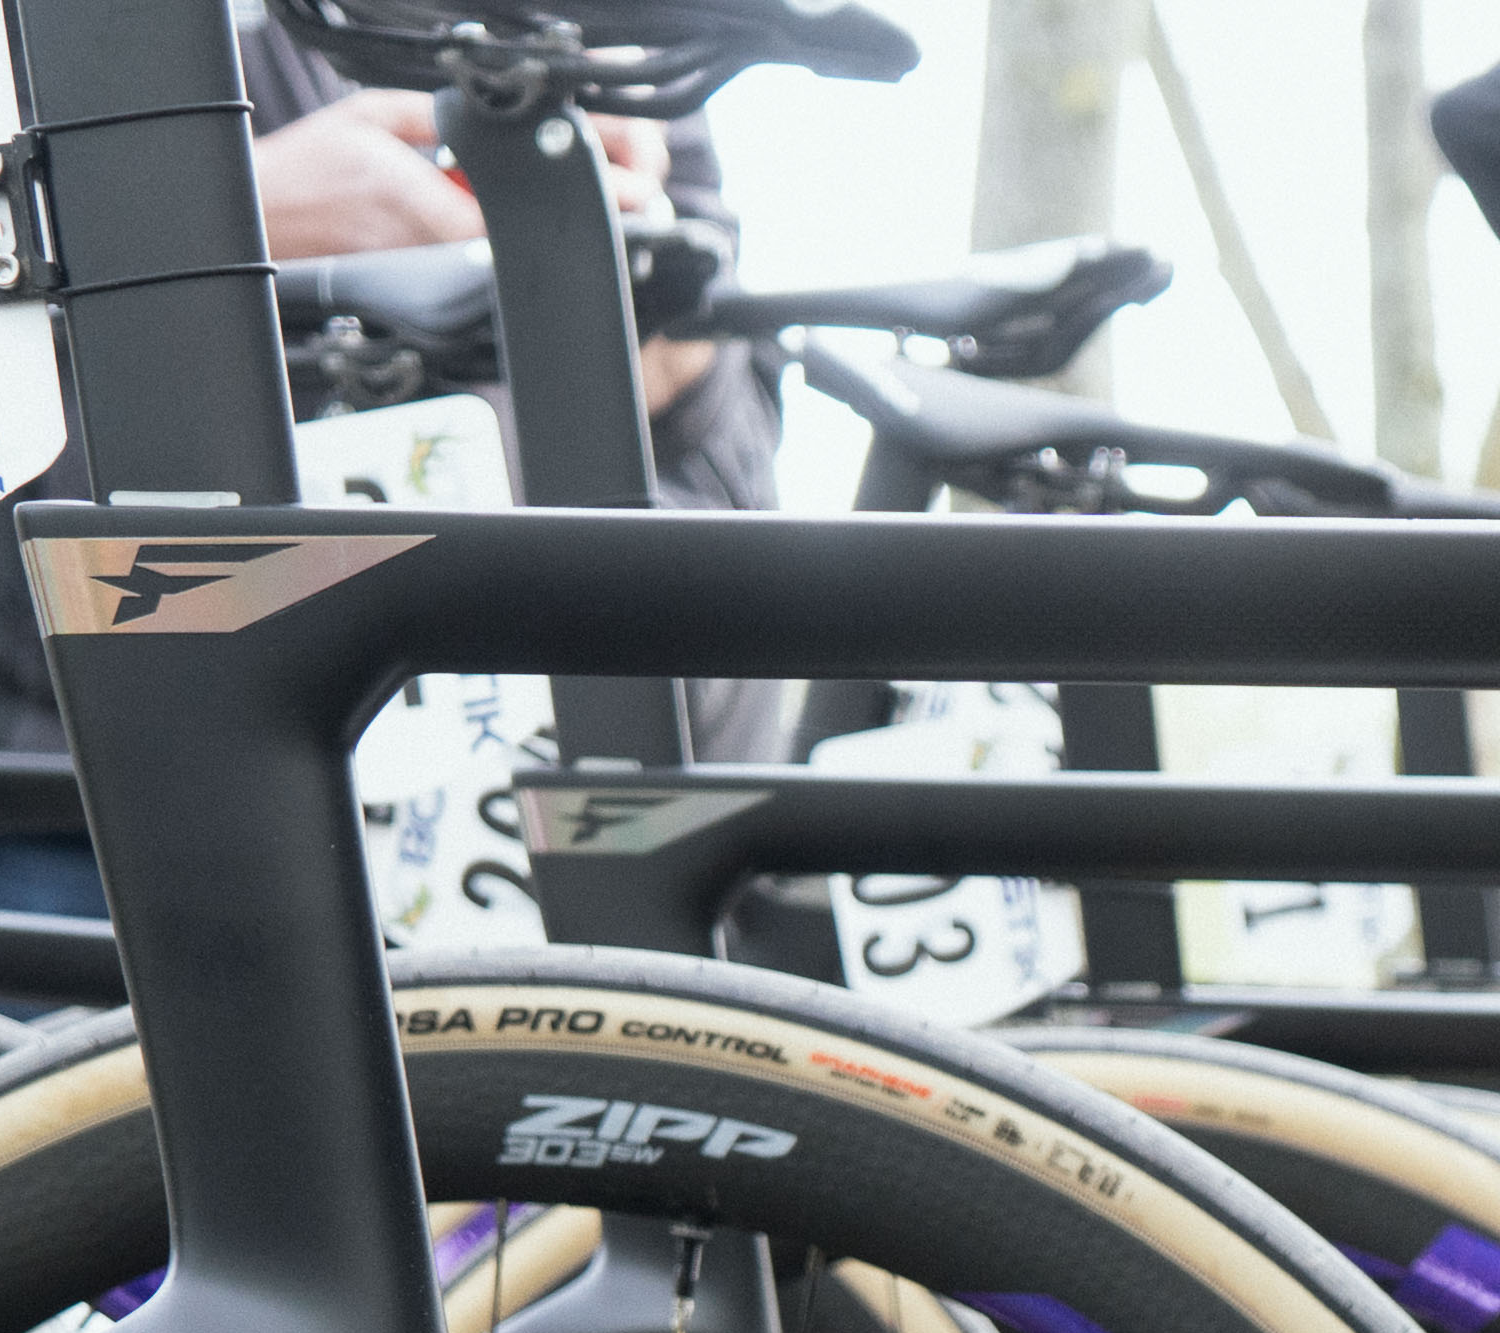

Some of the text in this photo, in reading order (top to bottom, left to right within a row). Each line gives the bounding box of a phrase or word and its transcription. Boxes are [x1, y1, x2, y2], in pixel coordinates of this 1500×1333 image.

[497, 1007, 607, 1035] PRO
[620, 1020, 790, 1065] CONTROL
[504, 1092, 799, 1162] ZIPP
